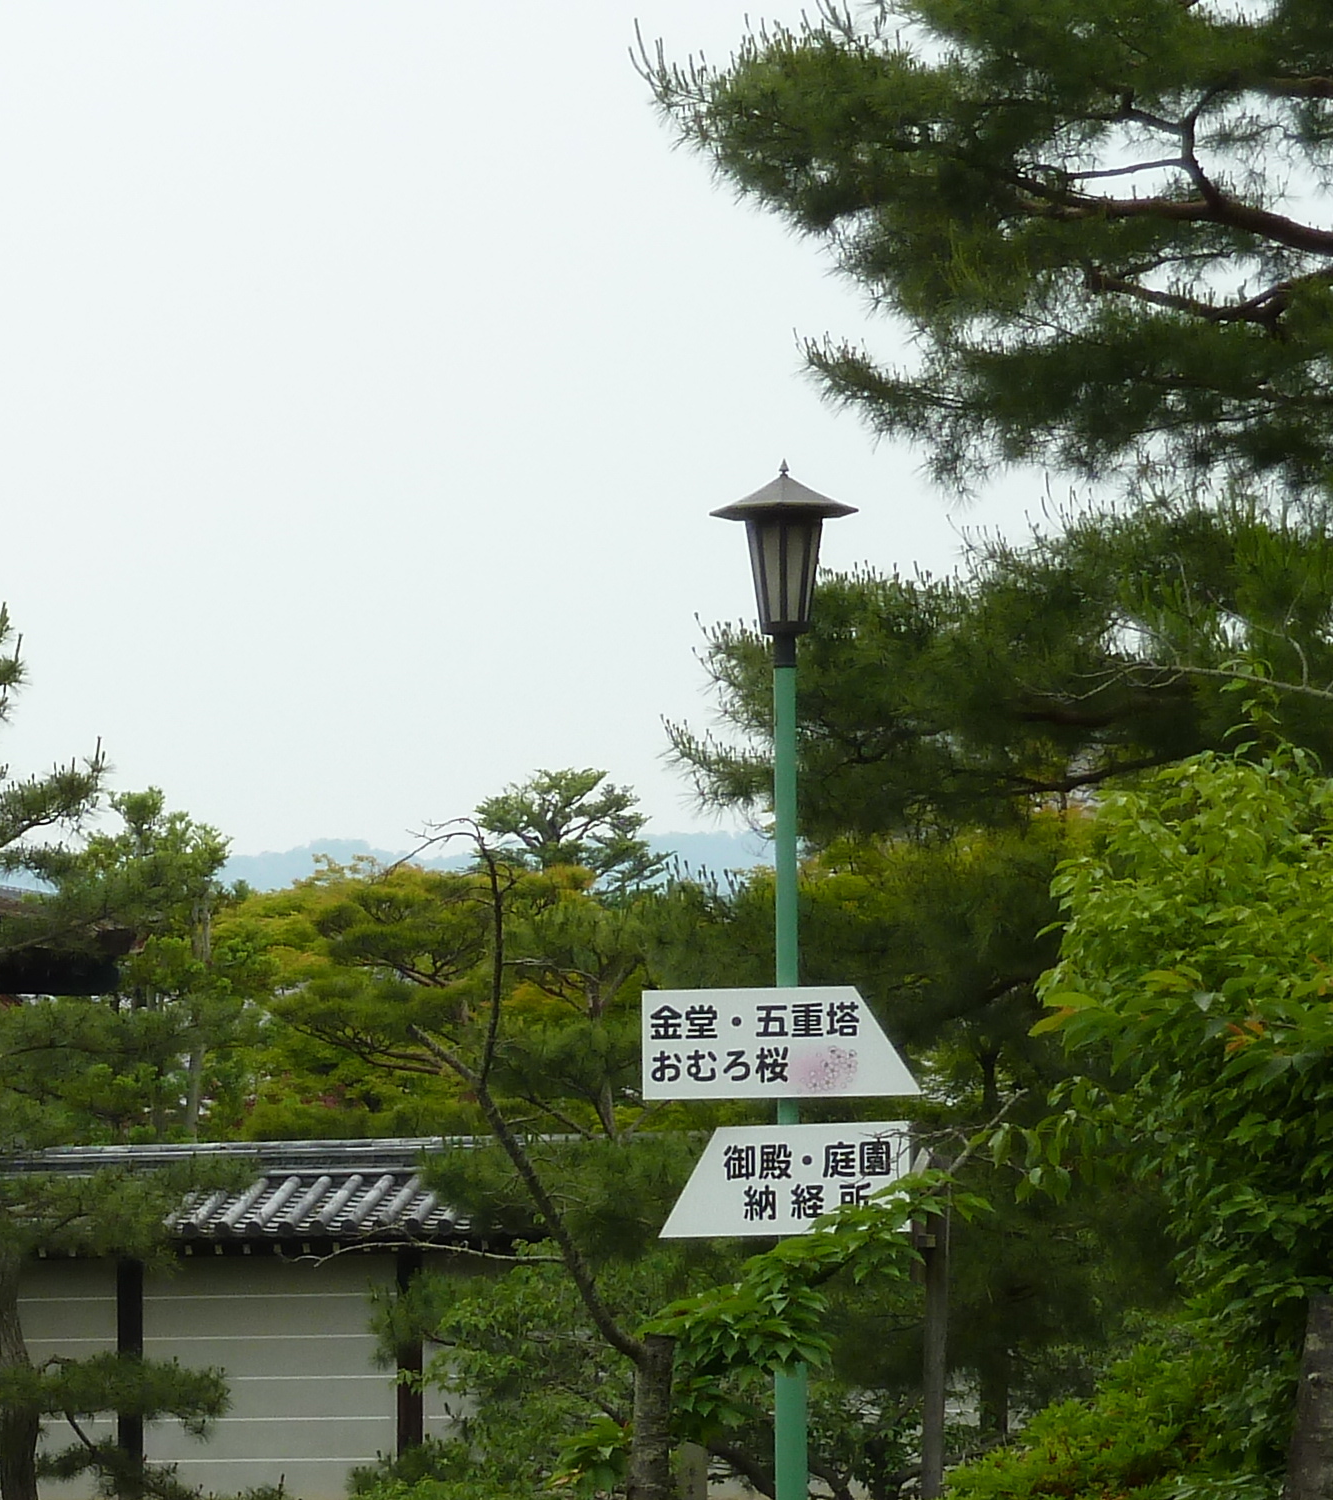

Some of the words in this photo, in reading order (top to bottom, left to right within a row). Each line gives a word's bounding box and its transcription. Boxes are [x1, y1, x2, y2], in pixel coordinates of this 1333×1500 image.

[650, 1001, 860, 1040] 金堂・五重塔
[650, 1047, 789, 1083] おむろ桜
[723, 1141, 891, 1181] 御殿・庭園
